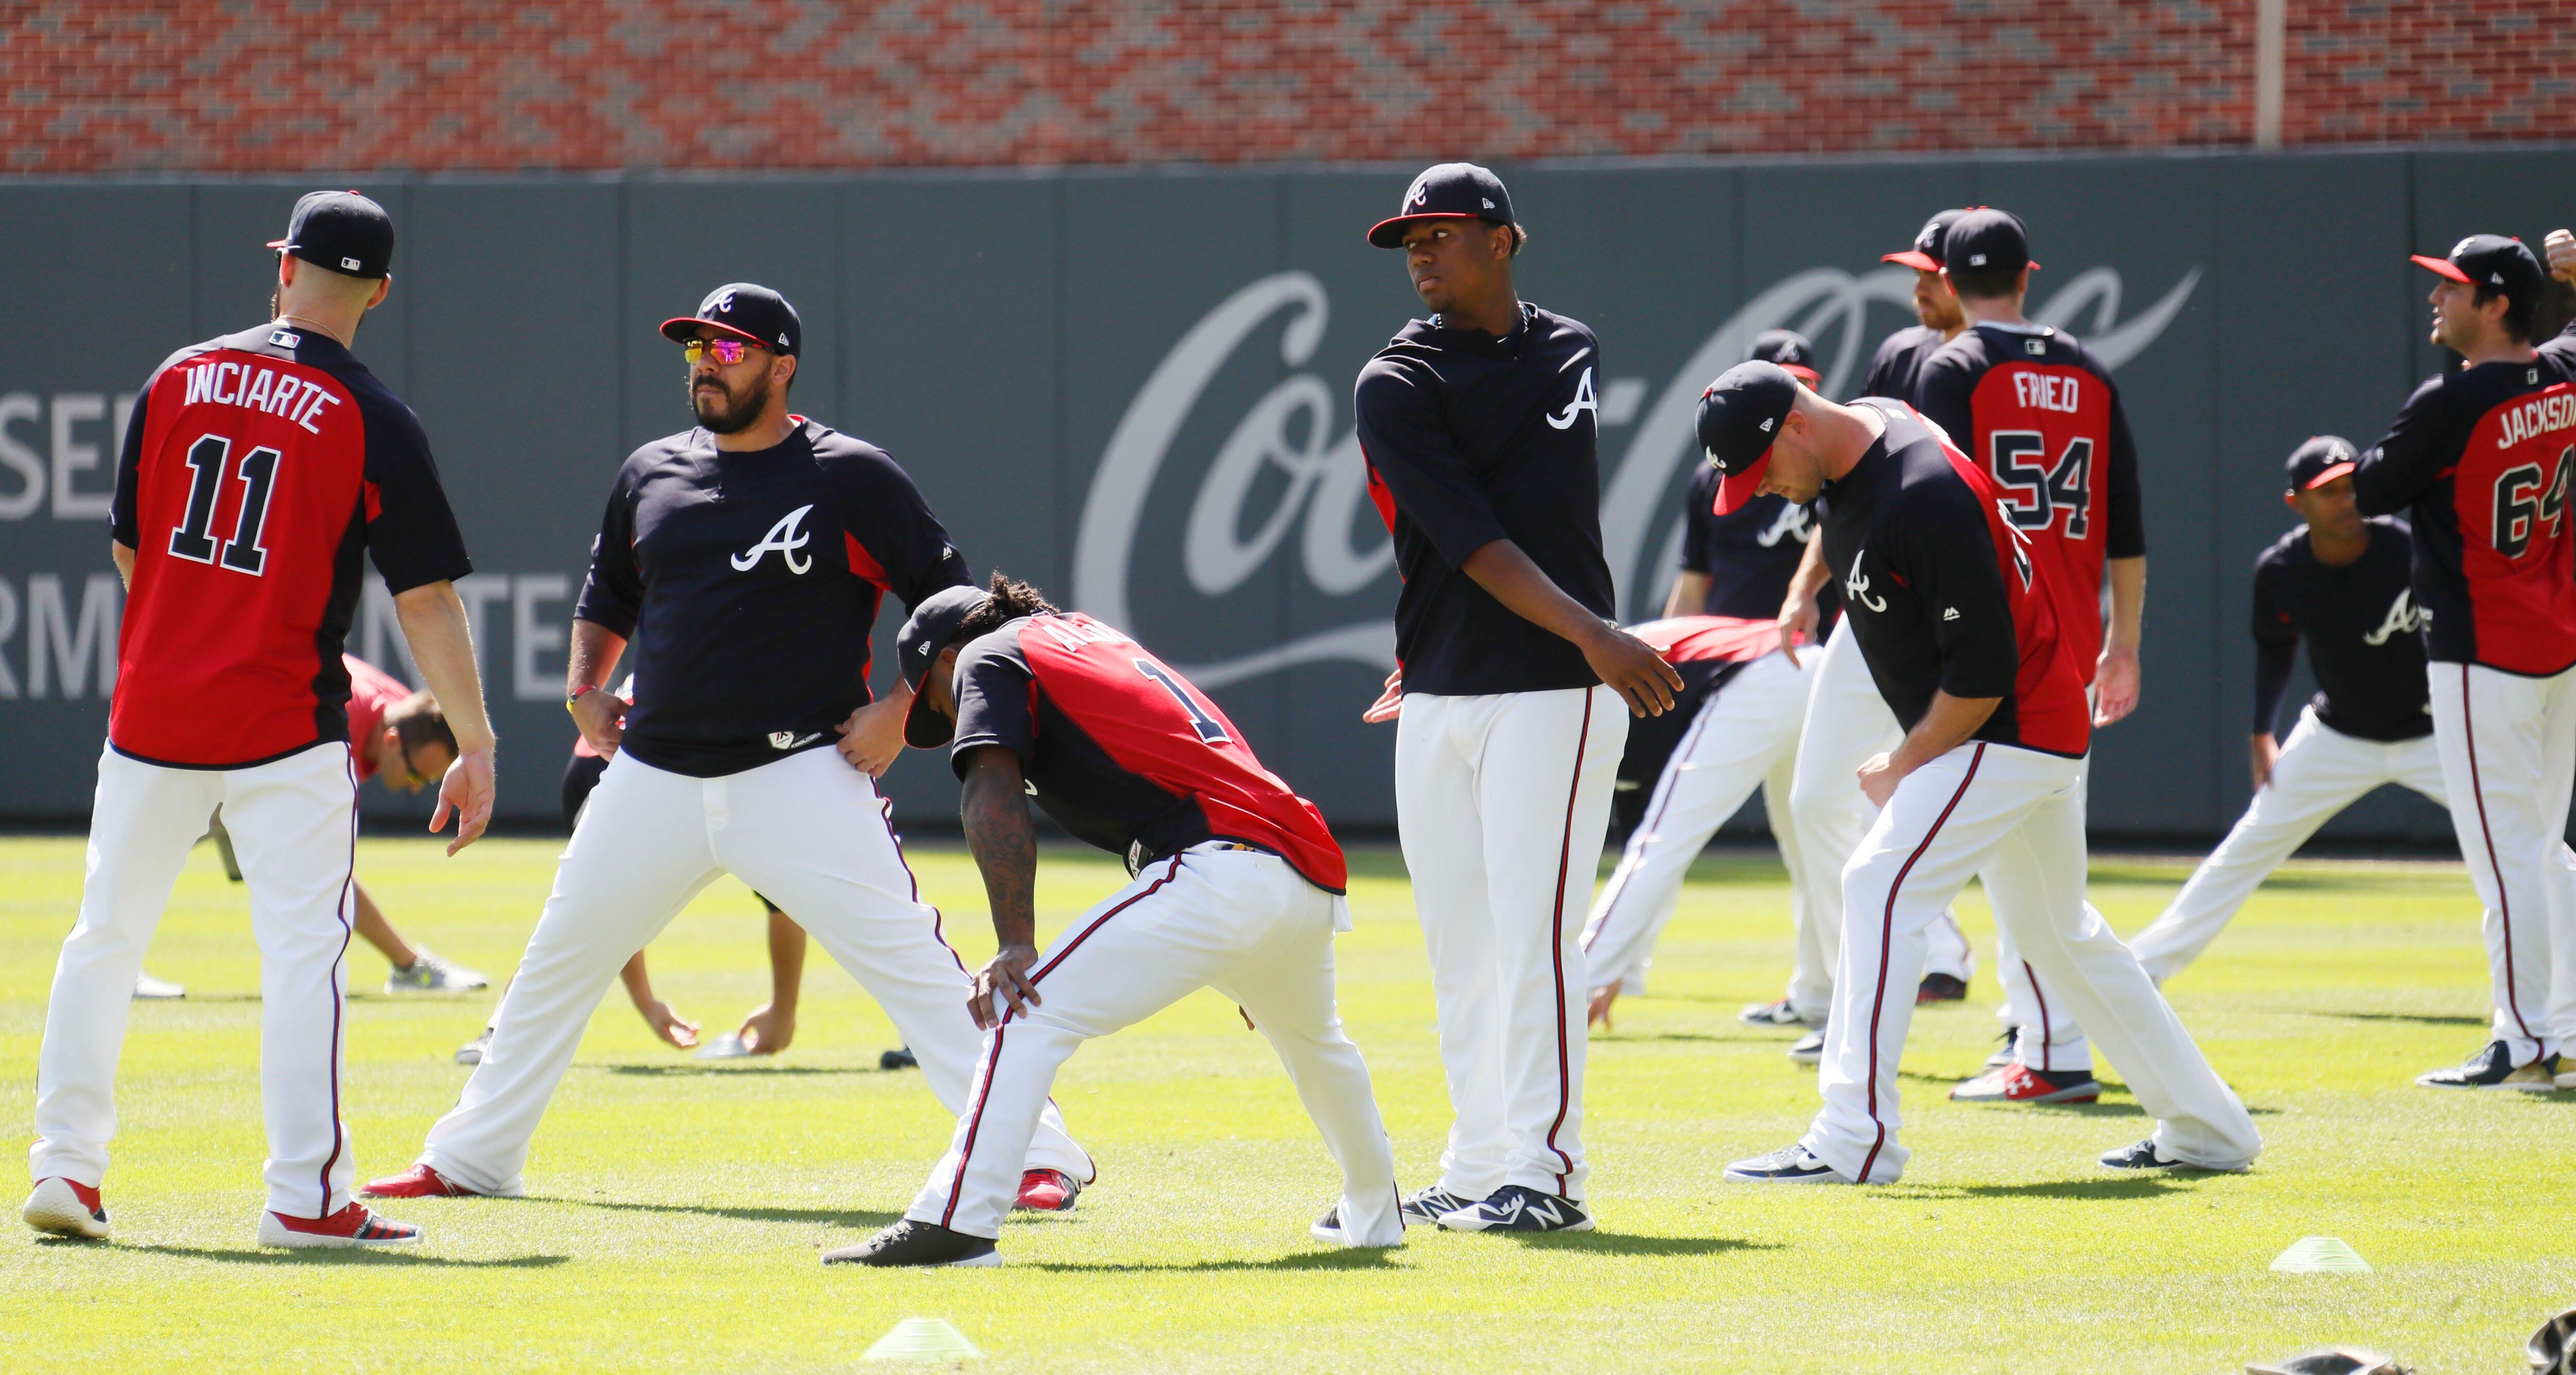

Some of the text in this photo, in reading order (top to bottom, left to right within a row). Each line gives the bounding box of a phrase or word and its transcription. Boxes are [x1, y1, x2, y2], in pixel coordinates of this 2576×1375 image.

[703, 288, 737, 313] A
[184, 362, 341, 434] INCIARTE
[2013, 371, 2078, 413] FRIED
[0, 393, 135, 520] SE
[1990, 430, 2094, 540] 54
[167, 433, 281, 577] 11
[731, 504, 814, 574] A
[2492, 444, 2574, 560] 64
[1131, 657, 1232, 744] 1
